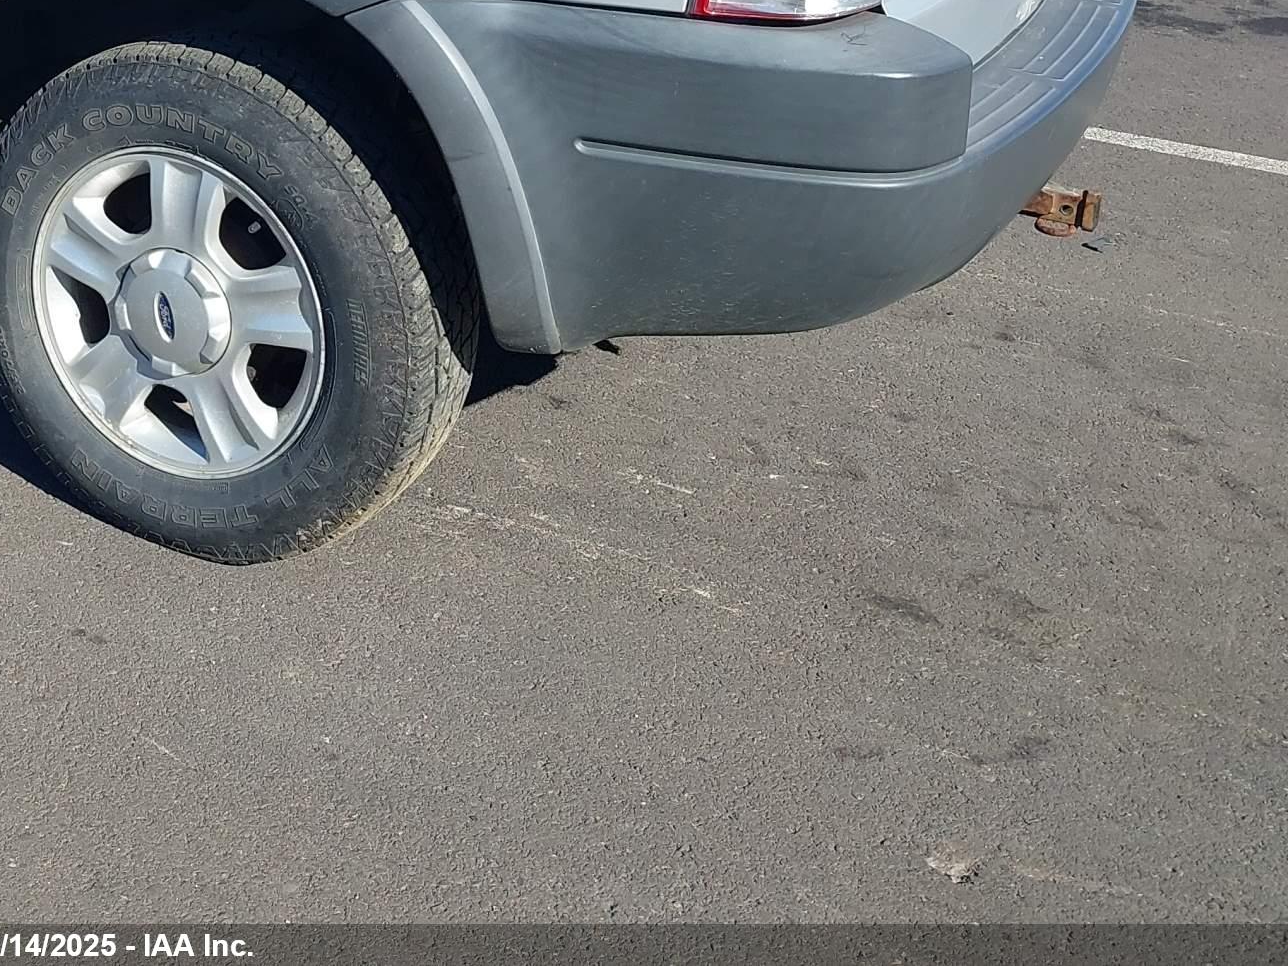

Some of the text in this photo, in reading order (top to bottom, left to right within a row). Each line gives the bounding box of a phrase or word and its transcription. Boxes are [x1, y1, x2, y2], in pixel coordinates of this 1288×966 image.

[1, 123, 75, 216] BACK
[82, 104, 283, 180] COUNTRY
[70, 443, 335, 529] ALL TERRAIN
